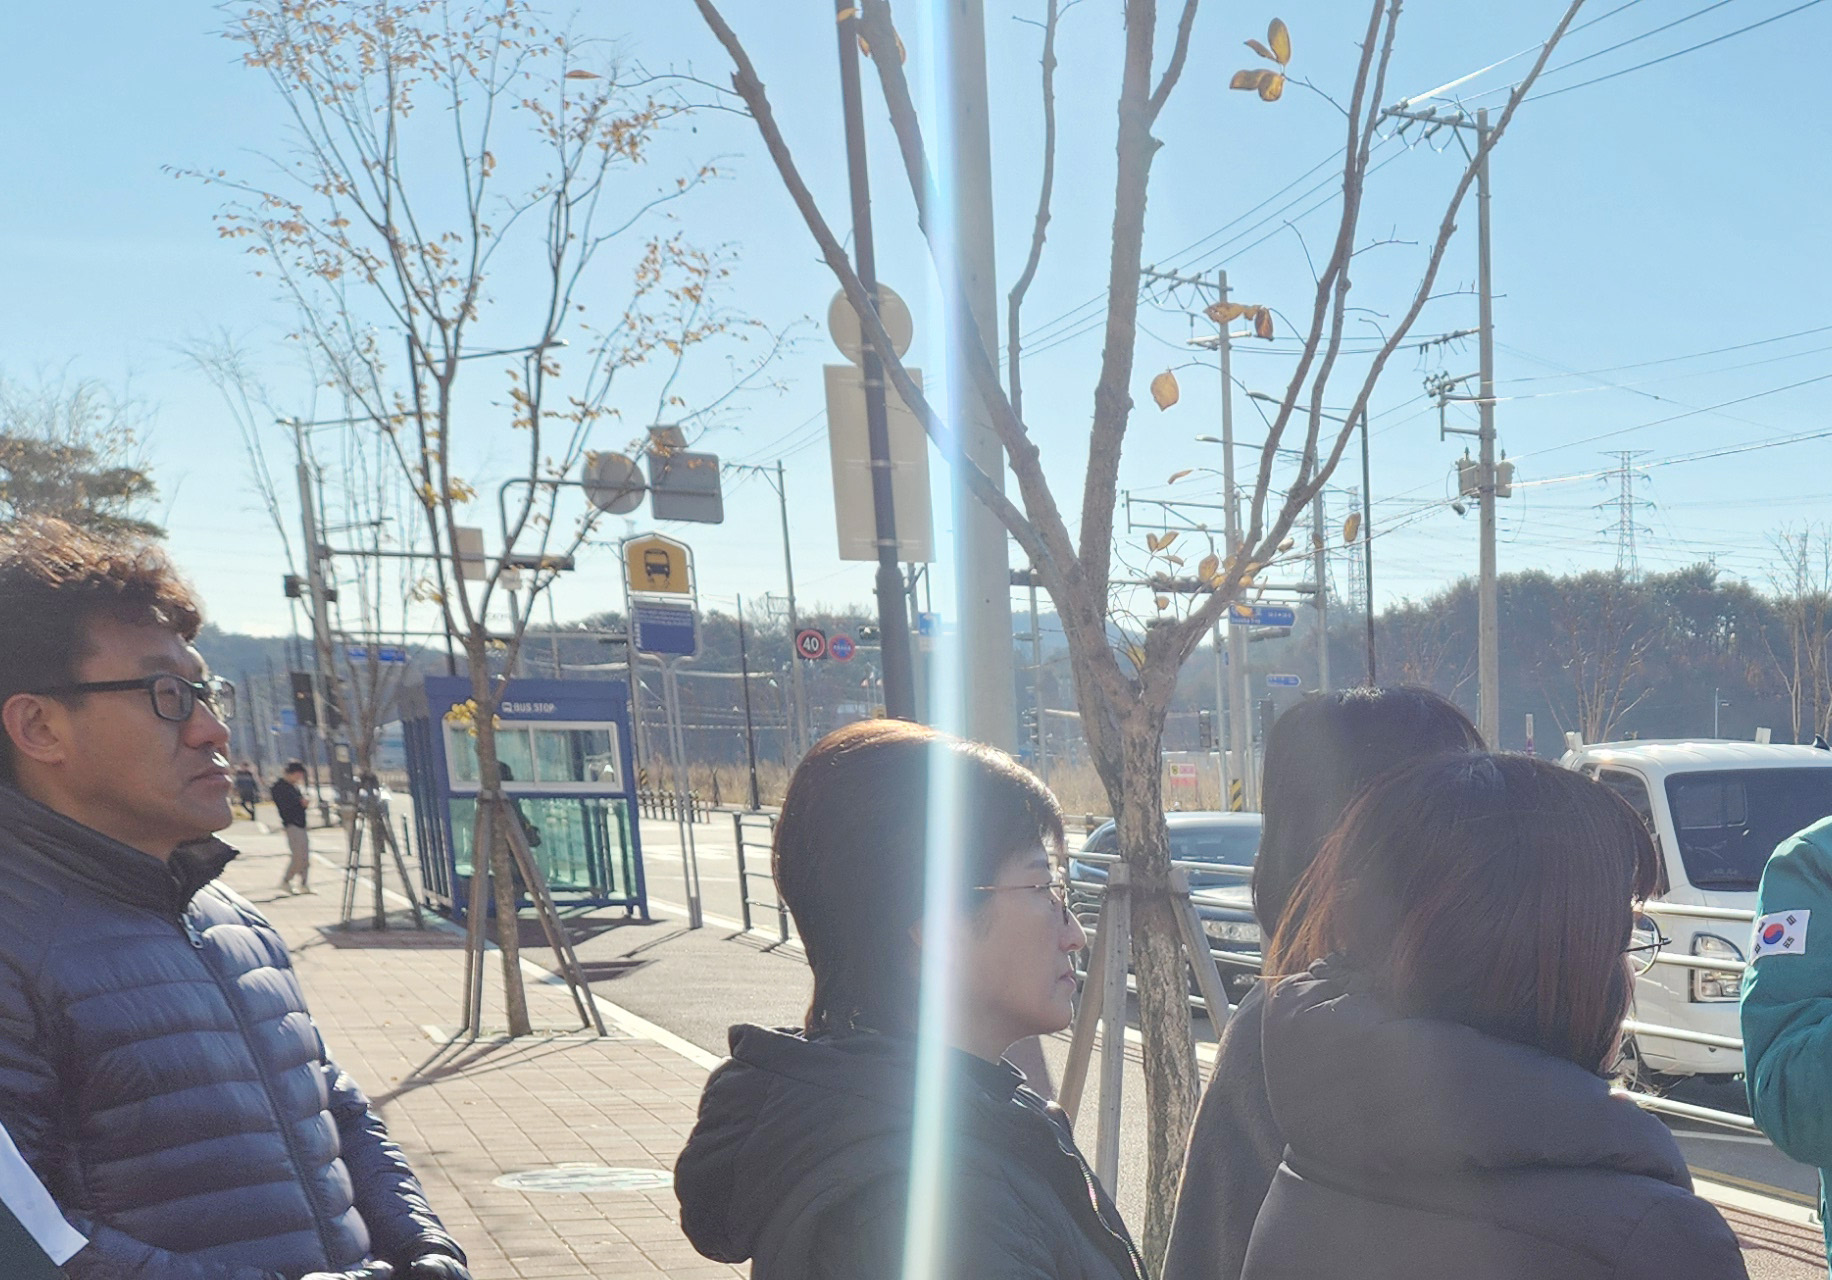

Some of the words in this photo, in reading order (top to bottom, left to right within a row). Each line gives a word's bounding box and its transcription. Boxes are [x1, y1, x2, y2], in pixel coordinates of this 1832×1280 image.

[802, 637, 820, 651] 40
[513, 702, 531, 713] BUS
[533, 702, 556, 713] STOP
